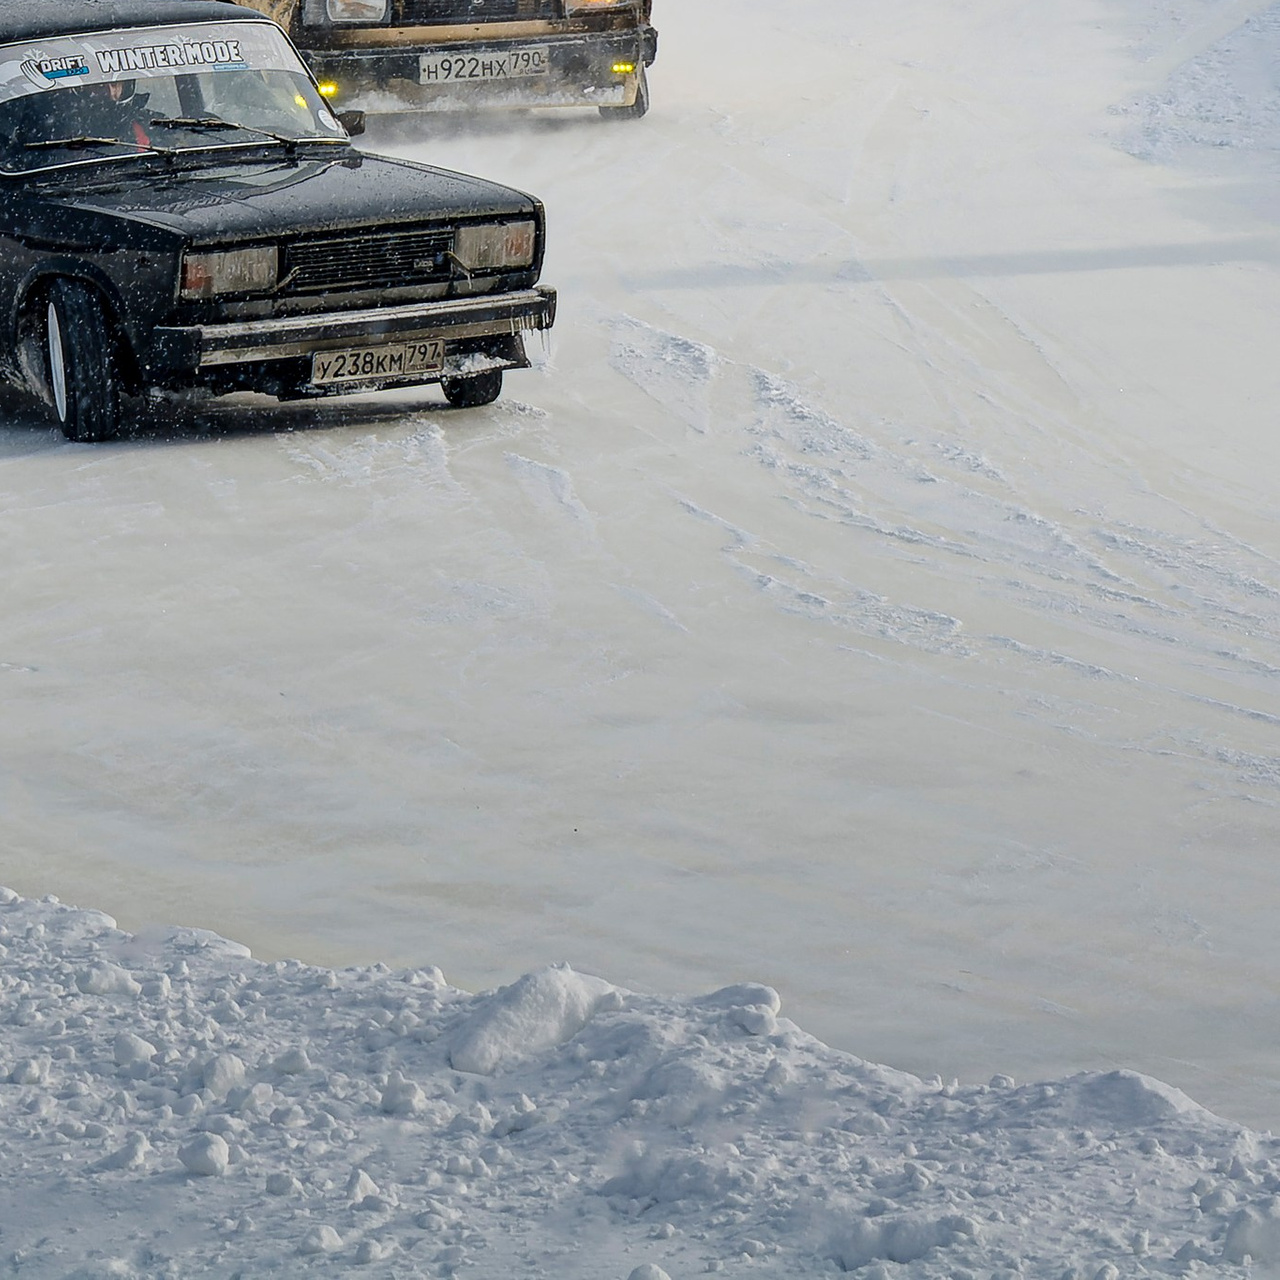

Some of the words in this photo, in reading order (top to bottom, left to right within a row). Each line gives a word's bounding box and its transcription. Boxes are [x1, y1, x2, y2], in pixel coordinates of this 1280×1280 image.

[40, 54, 85, 73] DRIFT
[95, 44, 183, 74] WINTER
[183, 39, 245, 66] MODE
[510, 51, 542, 70] 790
[407, 341, 440, 364] 797
